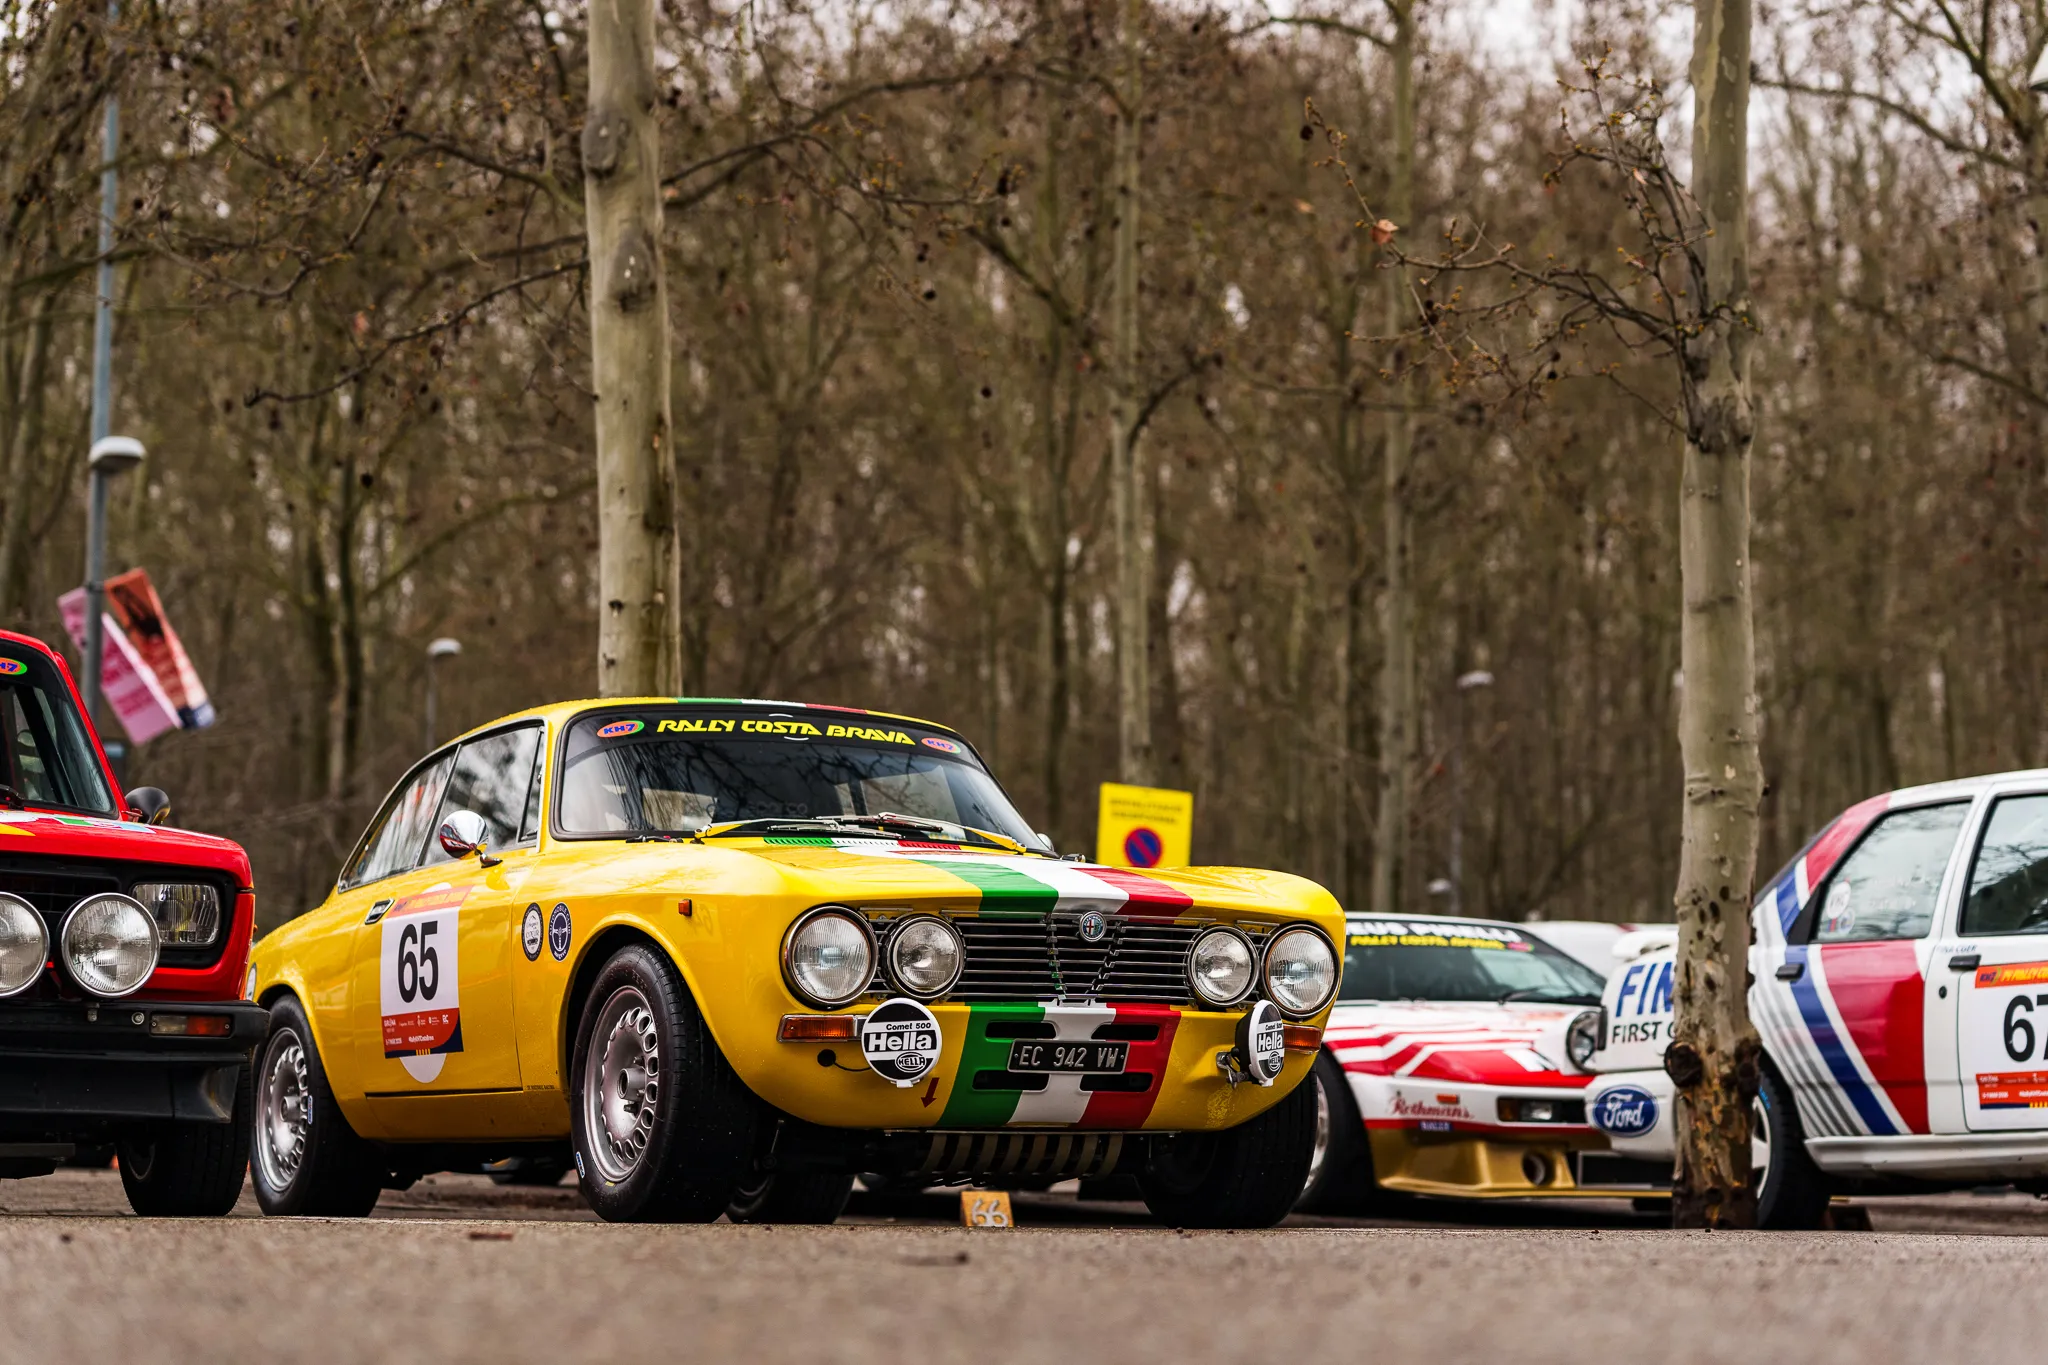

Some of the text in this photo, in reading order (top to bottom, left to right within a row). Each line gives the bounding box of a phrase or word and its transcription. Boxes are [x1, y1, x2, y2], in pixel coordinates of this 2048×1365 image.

[603, 723, 636, 735] KH7
[656, 719, 916, 746] RALLY COSTA BRAVA
[926, 739, 954, 751] KH7
[397, 920, 439, 1004] 65
[886, 1022, 932, 1031] Comet 500
[1611, 1021, 1662, 1044] FIRST
[868, 1031, 932, 1052] Hella
[1257, 1031, 1283, 1052] Hella
[898, 1056, 926, 1066] HELLA
[1019, 1046, 1119, 1068] EC 942 VW
[1603, 1092, 1645, 1129] Ford
[972, 1198, 1008, 1227] 66
